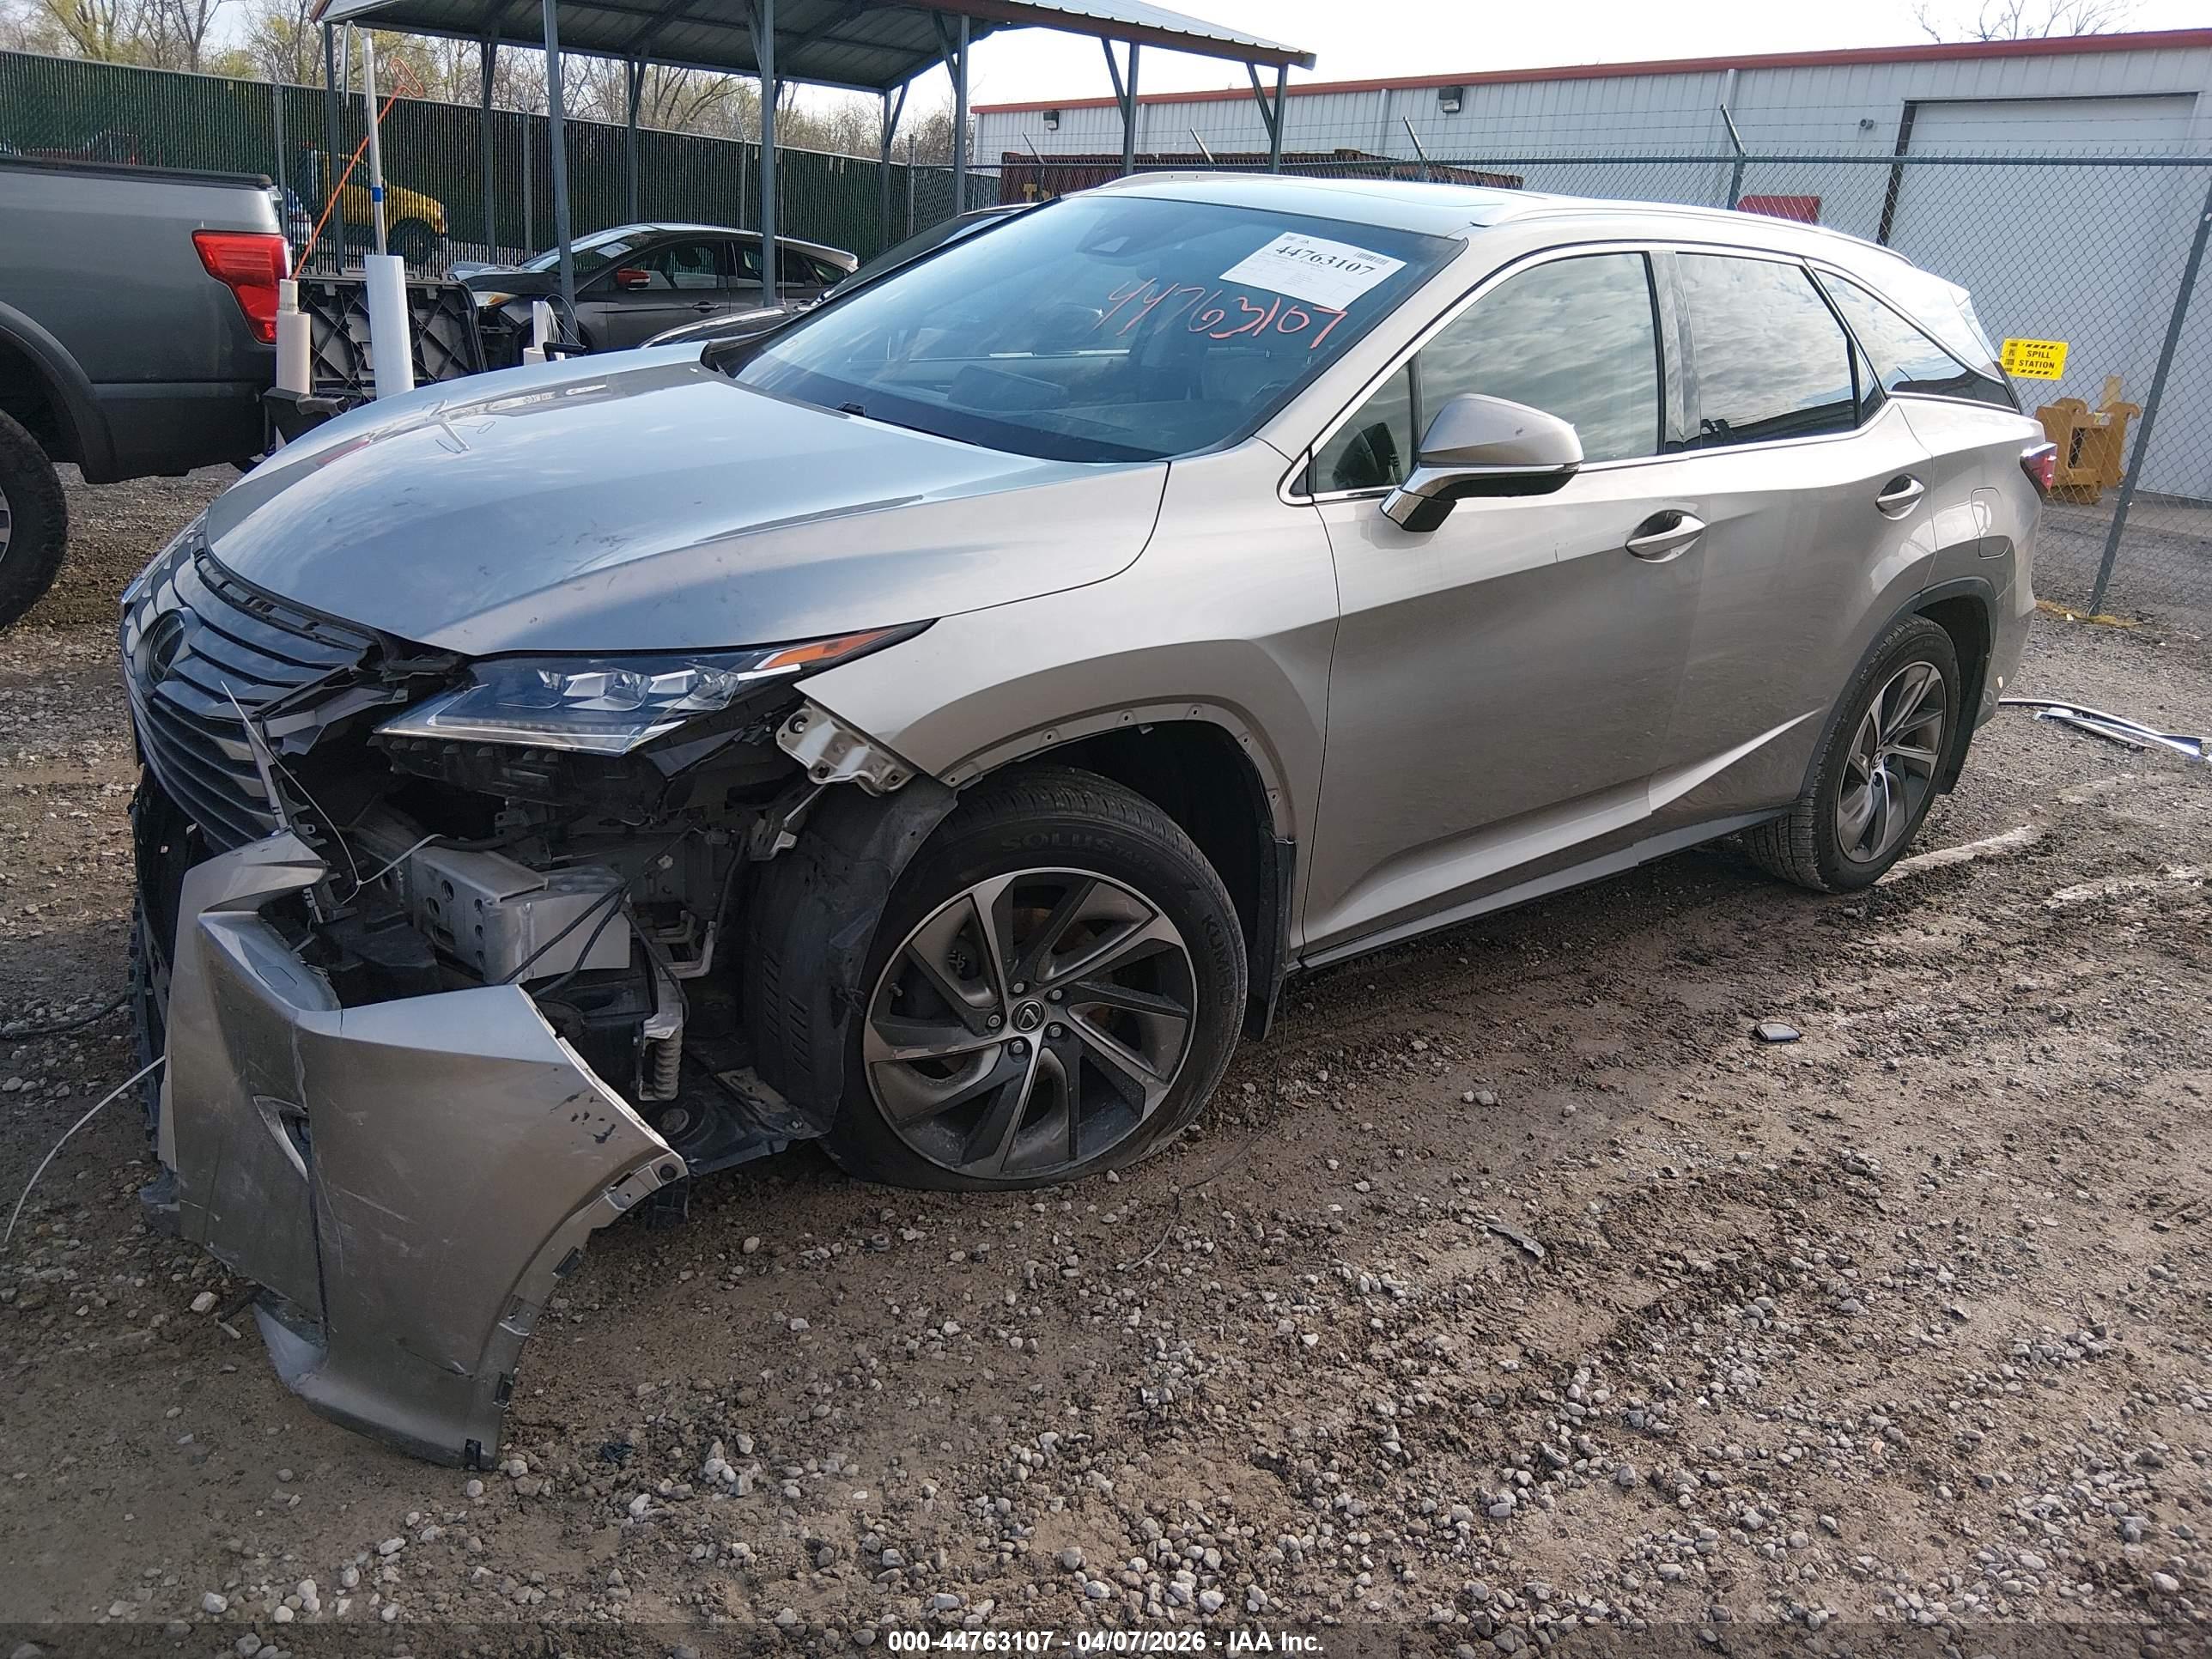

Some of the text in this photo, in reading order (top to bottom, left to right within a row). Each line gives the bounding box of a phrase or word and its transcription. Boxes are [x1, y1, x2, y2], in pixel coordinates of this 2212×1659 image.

[1275, 246, 1376, 276] 44763107
[1091, 276, 1348, 349] 44763107
[2019, 360, 2055, 368] STATION
[1000, 831, 1114, 853] SOLUS
